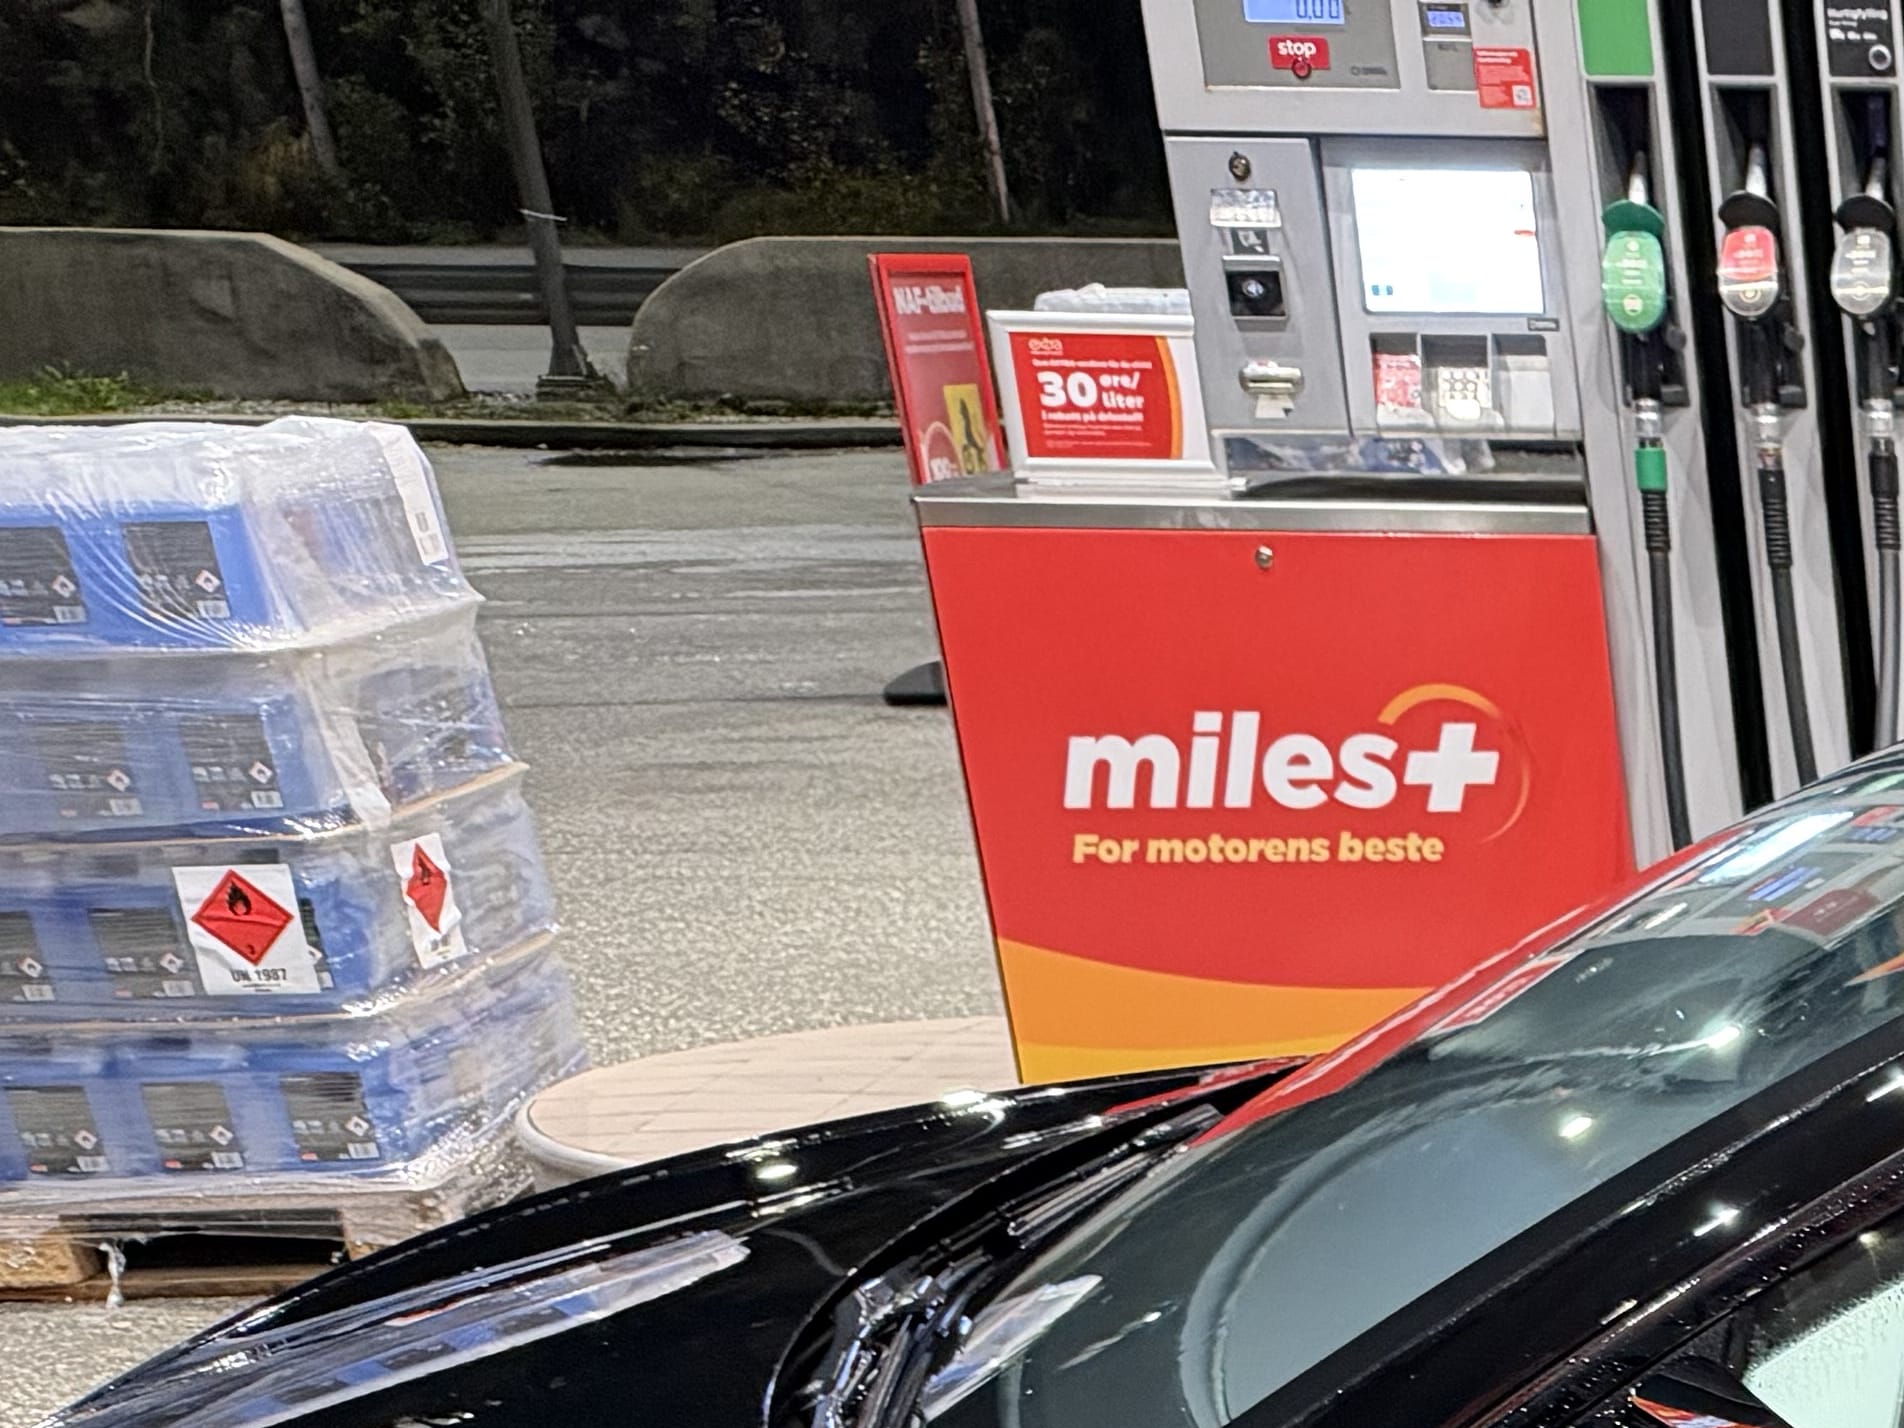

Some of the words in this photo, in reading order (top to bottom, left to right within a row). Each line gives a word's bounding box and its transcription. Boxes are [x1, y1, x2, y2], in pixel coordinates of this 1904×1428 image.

[1277, 40, 1317, 58] stop
[1036, 370, 1098, 409] 30
[1072, 834, 1139, 864] For
[1146, 834, 1331, 864] motorens
[1338, 831, 1445, 863] beste
[254, 967, 288, 981] 1987
